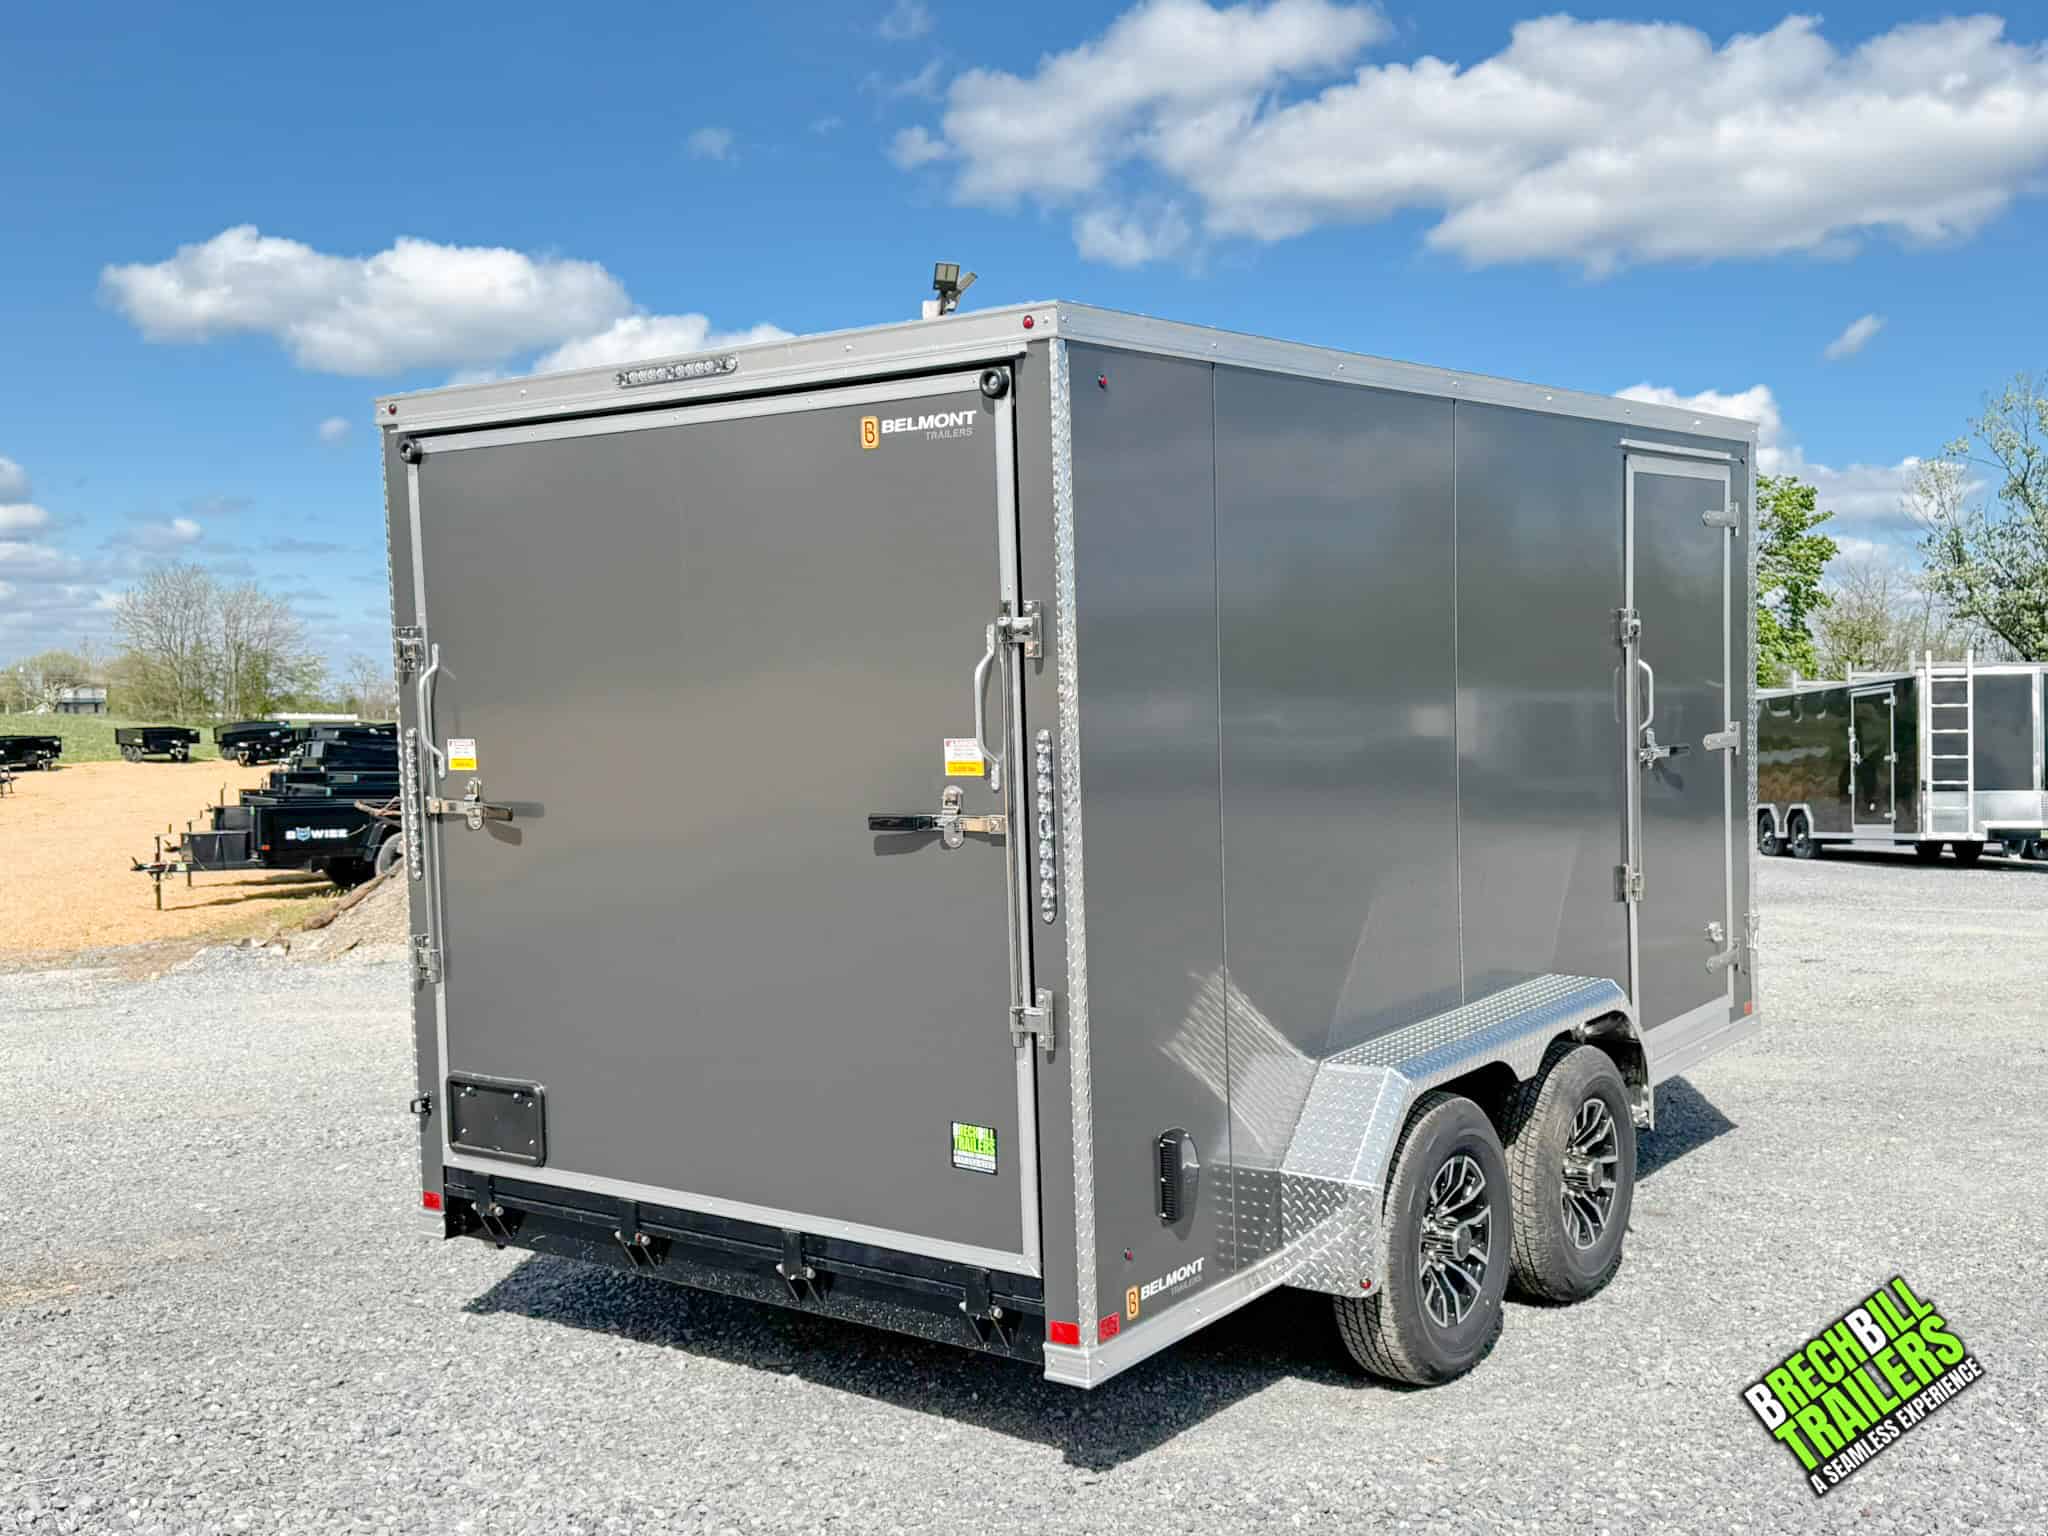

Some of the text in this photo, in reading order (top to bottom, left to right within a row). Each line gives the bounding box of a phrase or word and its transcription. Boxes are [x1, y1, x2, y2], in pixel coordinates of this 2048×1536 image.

[881, 410, 977, 434] BELMONT
[926, 427, 973, 441] TRAILERS
[1141, 1257, 1205, 1301] BELMONT
